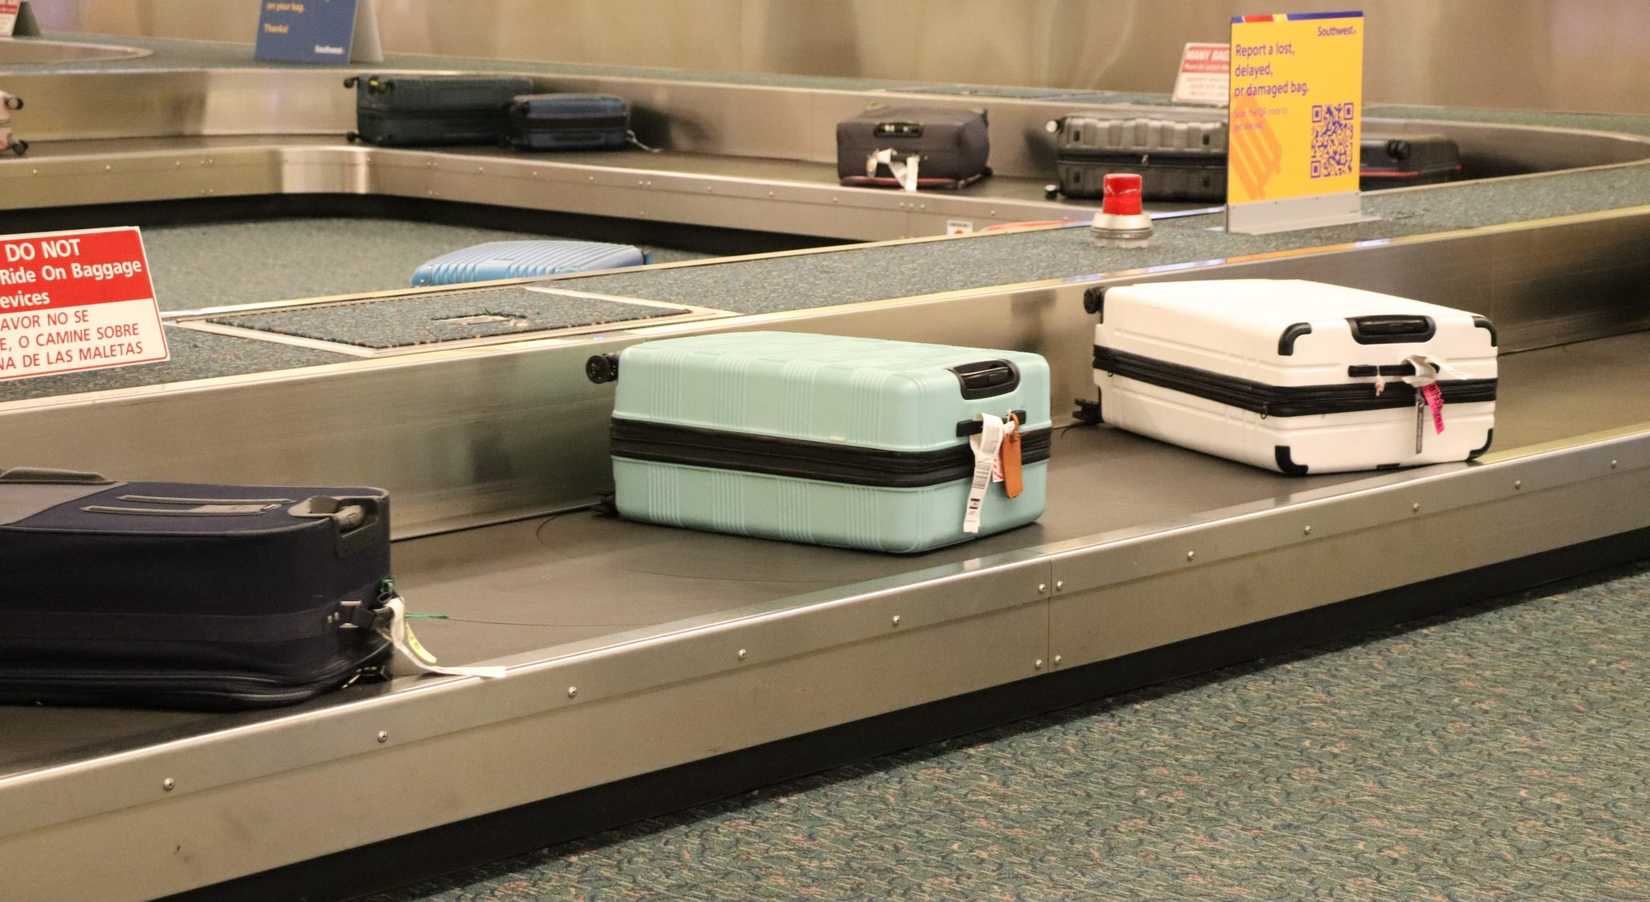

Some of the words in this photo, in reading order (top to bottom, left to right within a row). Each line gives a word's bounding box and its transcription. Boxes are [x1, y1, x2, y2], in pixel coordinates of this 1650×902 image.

[276, 4, 290, 12] your
[264, 23, 288, 33] Thanks!
[1235, 44, 1266, 59] Report
[1268, 45, 1273, 55] a
[1275, 42, 1295, 56] lost,
[1235, 63, 1273, 79] delayed,
[1234, 86, 1244, 97] or
[1246, 81, 1289, 98] damaged
[1290, 80, 1309, 96] bag.
[5, 242, 36, 262] DO
[42, 239, 81, 259] NOT
[0, 268, 36, 285] Ride
[42, 265, 66, 281] On
[71, 260, 142, 280] Baggage
[47, 312, 68, 326] NO
[74, 310, 89, 324] SE
[19, 335, 30, 349] O
[36, 329, 91, 347] CAMINE
[97, 323, 139, 340] SOBRE
[23, 354, 41, 368] DE
[47, 349, 73, 365] LAS
[79, 342, 143, 360] MALETAS
